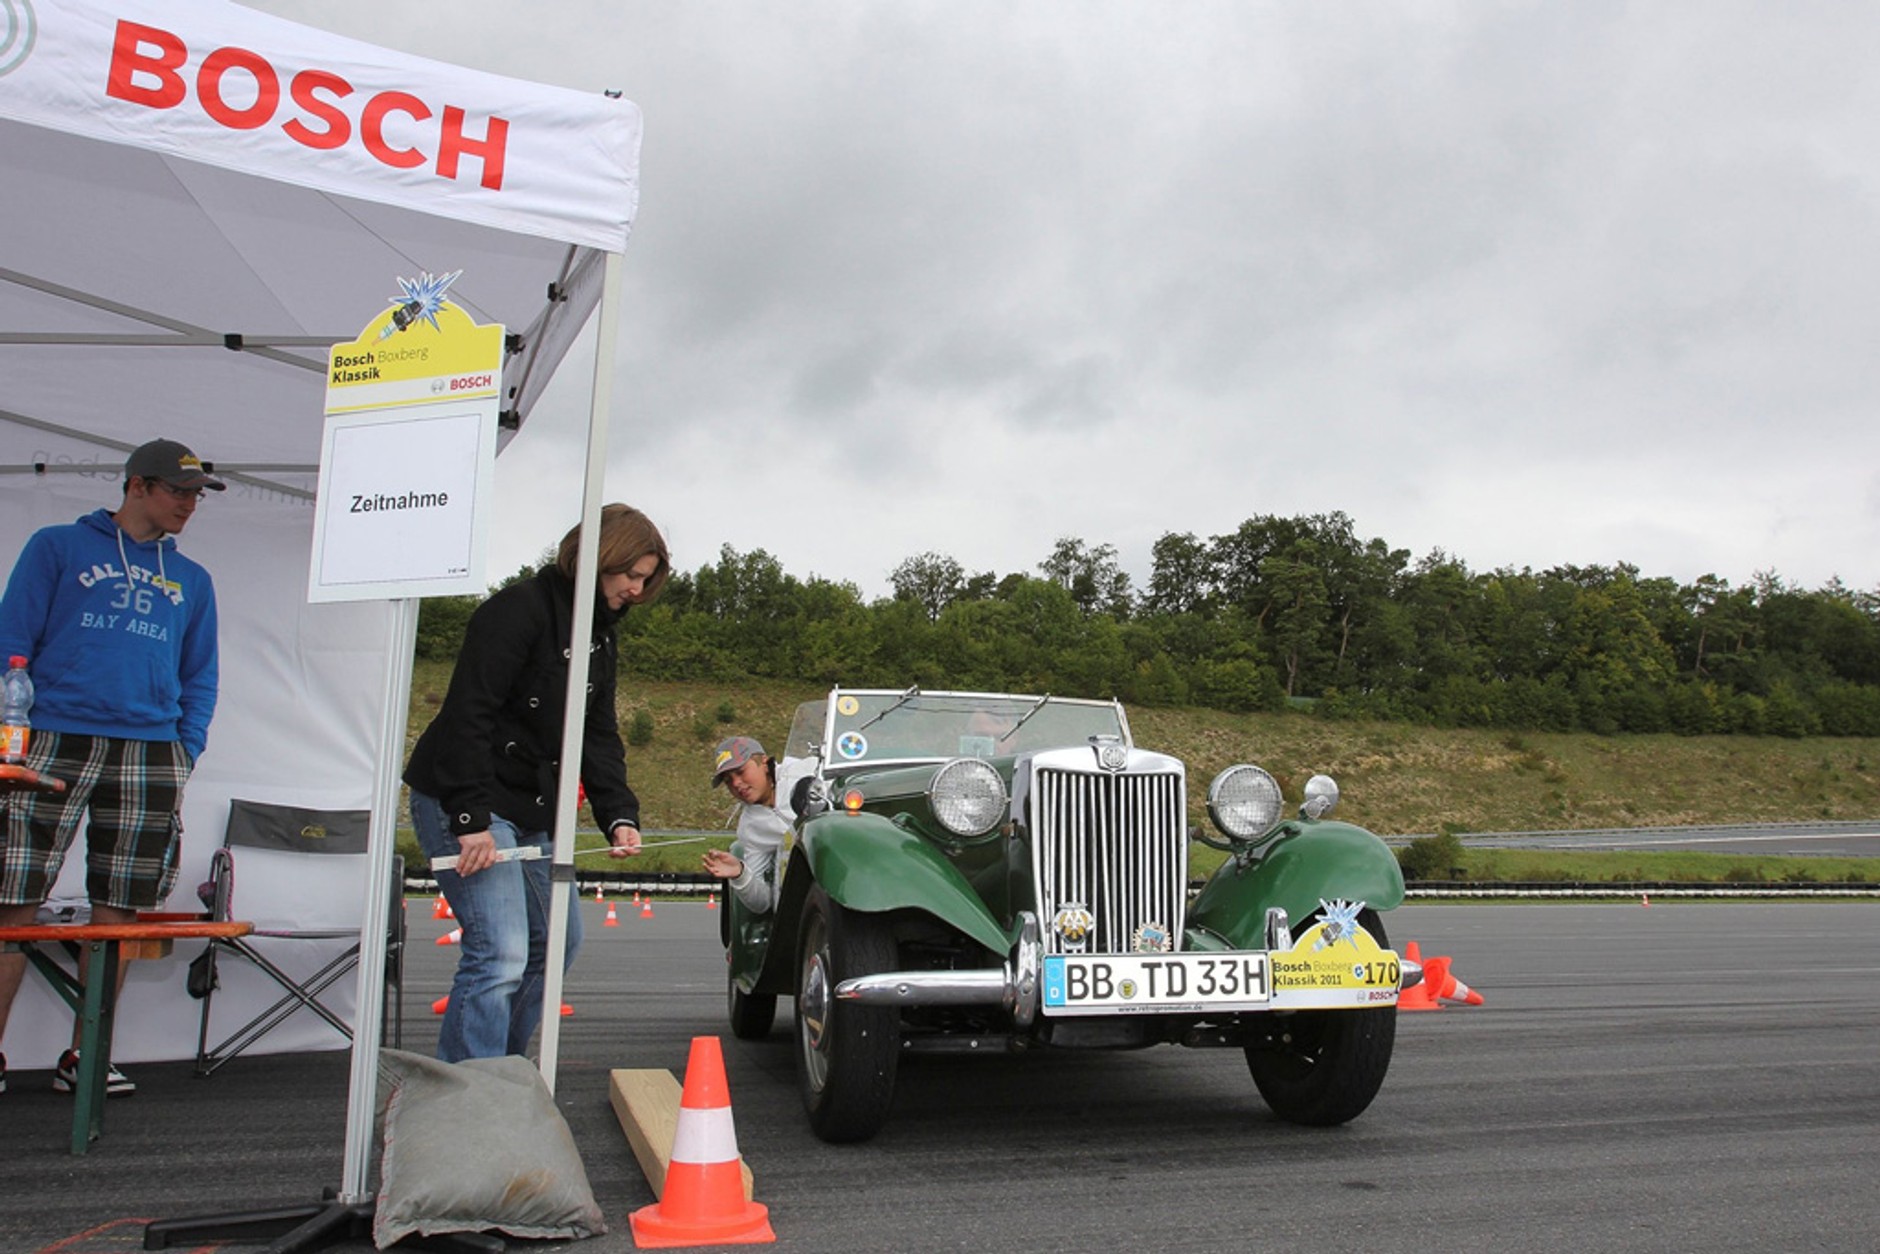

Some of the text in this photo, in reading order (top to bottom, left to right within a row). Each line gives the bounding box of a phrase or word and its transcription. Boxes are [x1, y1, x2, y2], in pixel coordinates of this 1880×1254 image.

[106, 18, 510, 191] BOSCH
[334, 347, 429, 368] Bosch Boxberg
[332, 367, 381, 383] Klassik
[450, 375, 492, 390] BOSCH
[350, 491, 448, 513] Zeitnahme
[110, 582, 154, 615] 36
[80, 612, 168, 642] BAY AREA
[1272, 961, 1312, 972] Bosch
[1364, 961, 1398, 985] 170
[1066, 962, 1114, 1000] BB
[1141, 961, 1188, 998] TD
[1197, 959, 1267, 996] 33H
[1273, 974, 1342, 986] Klassik 2011
